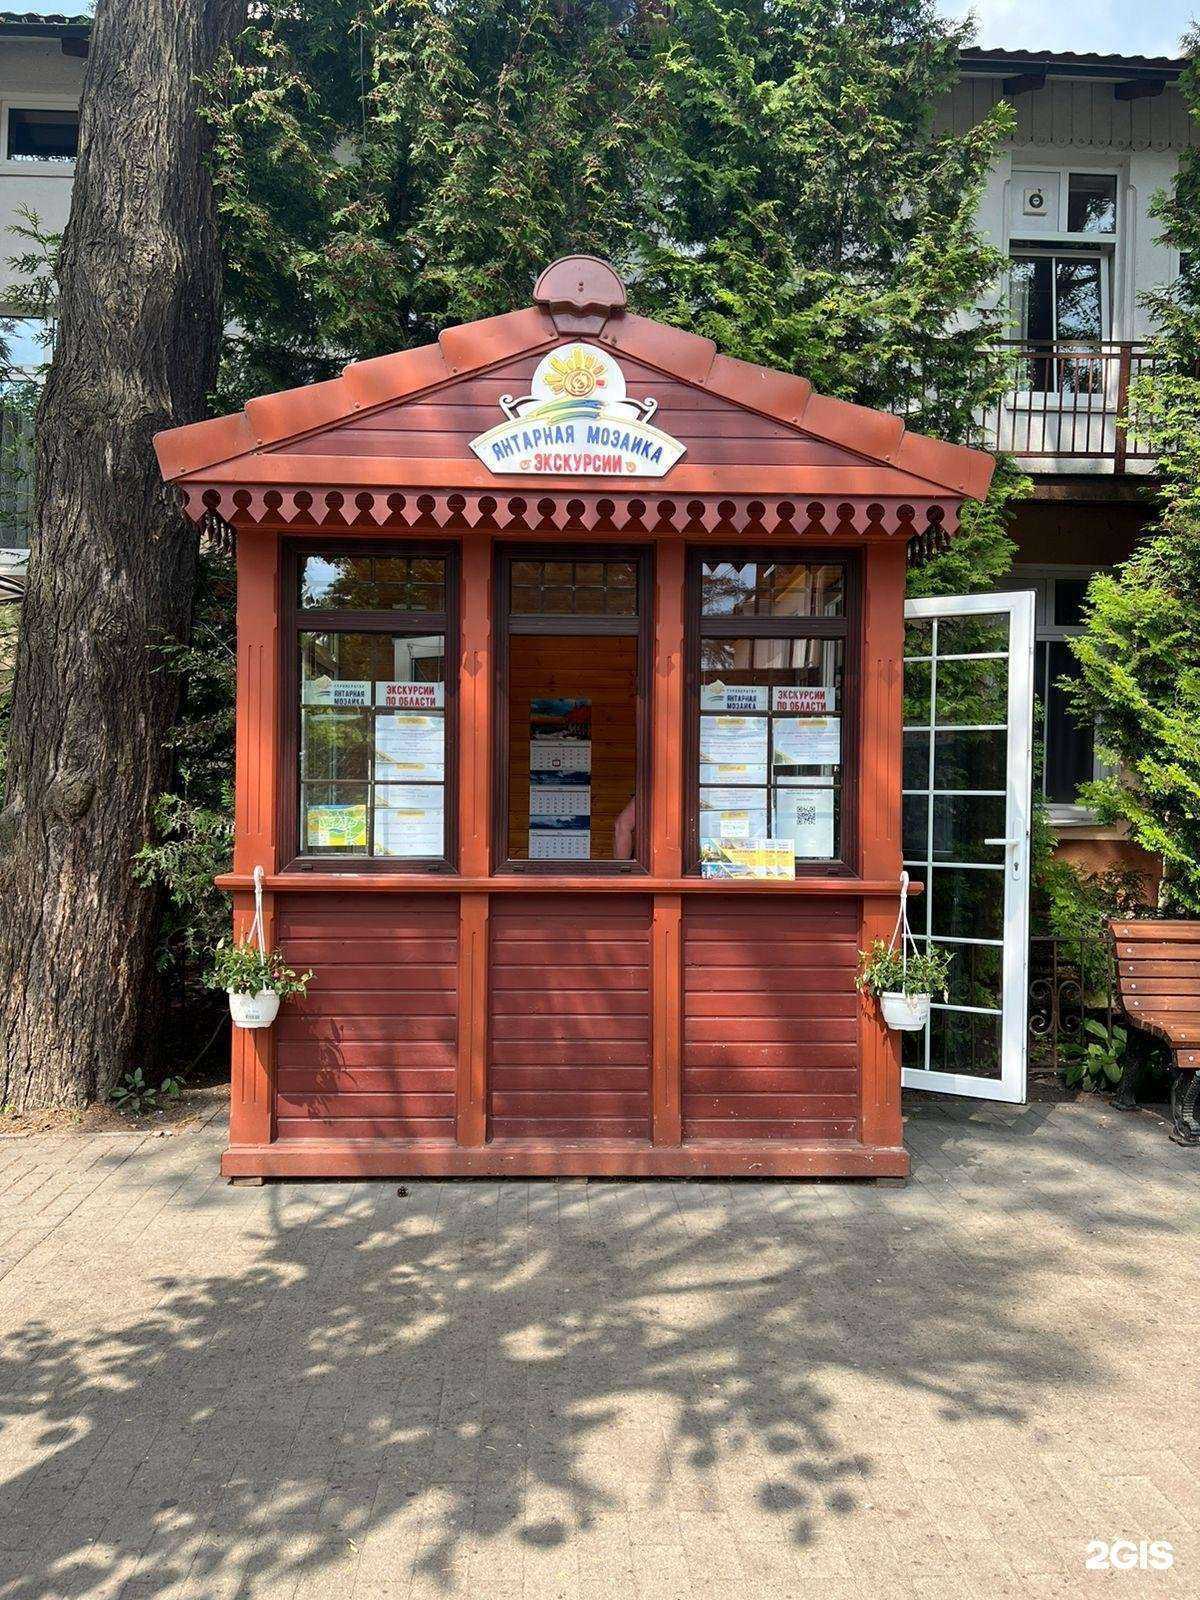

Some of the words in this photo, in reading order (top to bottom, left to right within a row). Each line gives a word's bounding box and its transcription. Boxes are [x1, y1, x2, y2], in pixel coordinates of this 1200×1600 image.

[491, 425, 575, 461] ЯНТАРНАЯ
[587, 425, 665, 464] МОЗАИКА
[534, 453, 622, 473] ЭКСКУРСИИ
[334, 690, 365, 698] ЯНТАРНАЯ
[386, 686, 435, 695] ЭКСКУРСИИ
[777, 690, 826, 700] ЭКСКУРСИИ
[386, 697, 396, 706] ПО
[399, 697, 436, 707] ОБЛАСТИ
[726, 694, 757, 702] ЯНТАРНАЯ
[776, 701, 787, 711] ПО
[790, 701, 827, 711] ОБЛАСТИ
